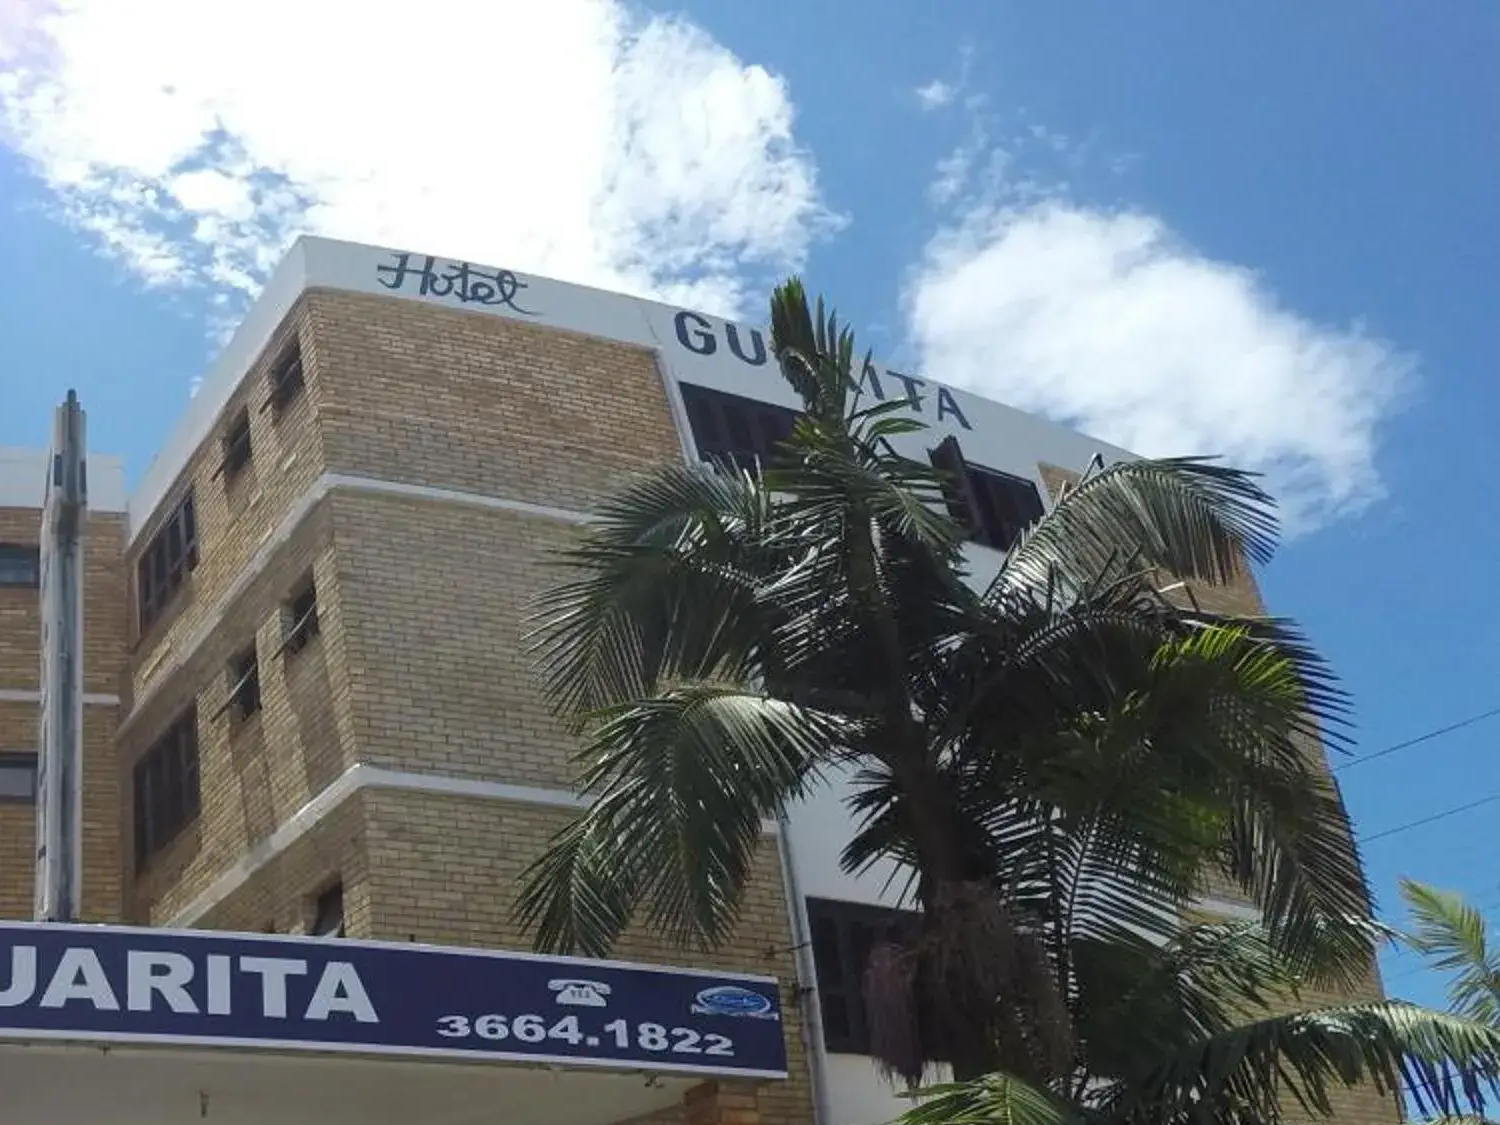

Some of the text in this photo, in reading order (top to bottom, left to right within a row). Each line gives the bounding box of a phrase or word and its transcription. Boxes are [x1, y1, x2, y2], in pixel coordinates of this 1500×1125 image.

[377, 252, 546, 315] Hotel
[674, 311, 973, 431] GUITA
[436, 1013, 735, 1058] 3664.1822
